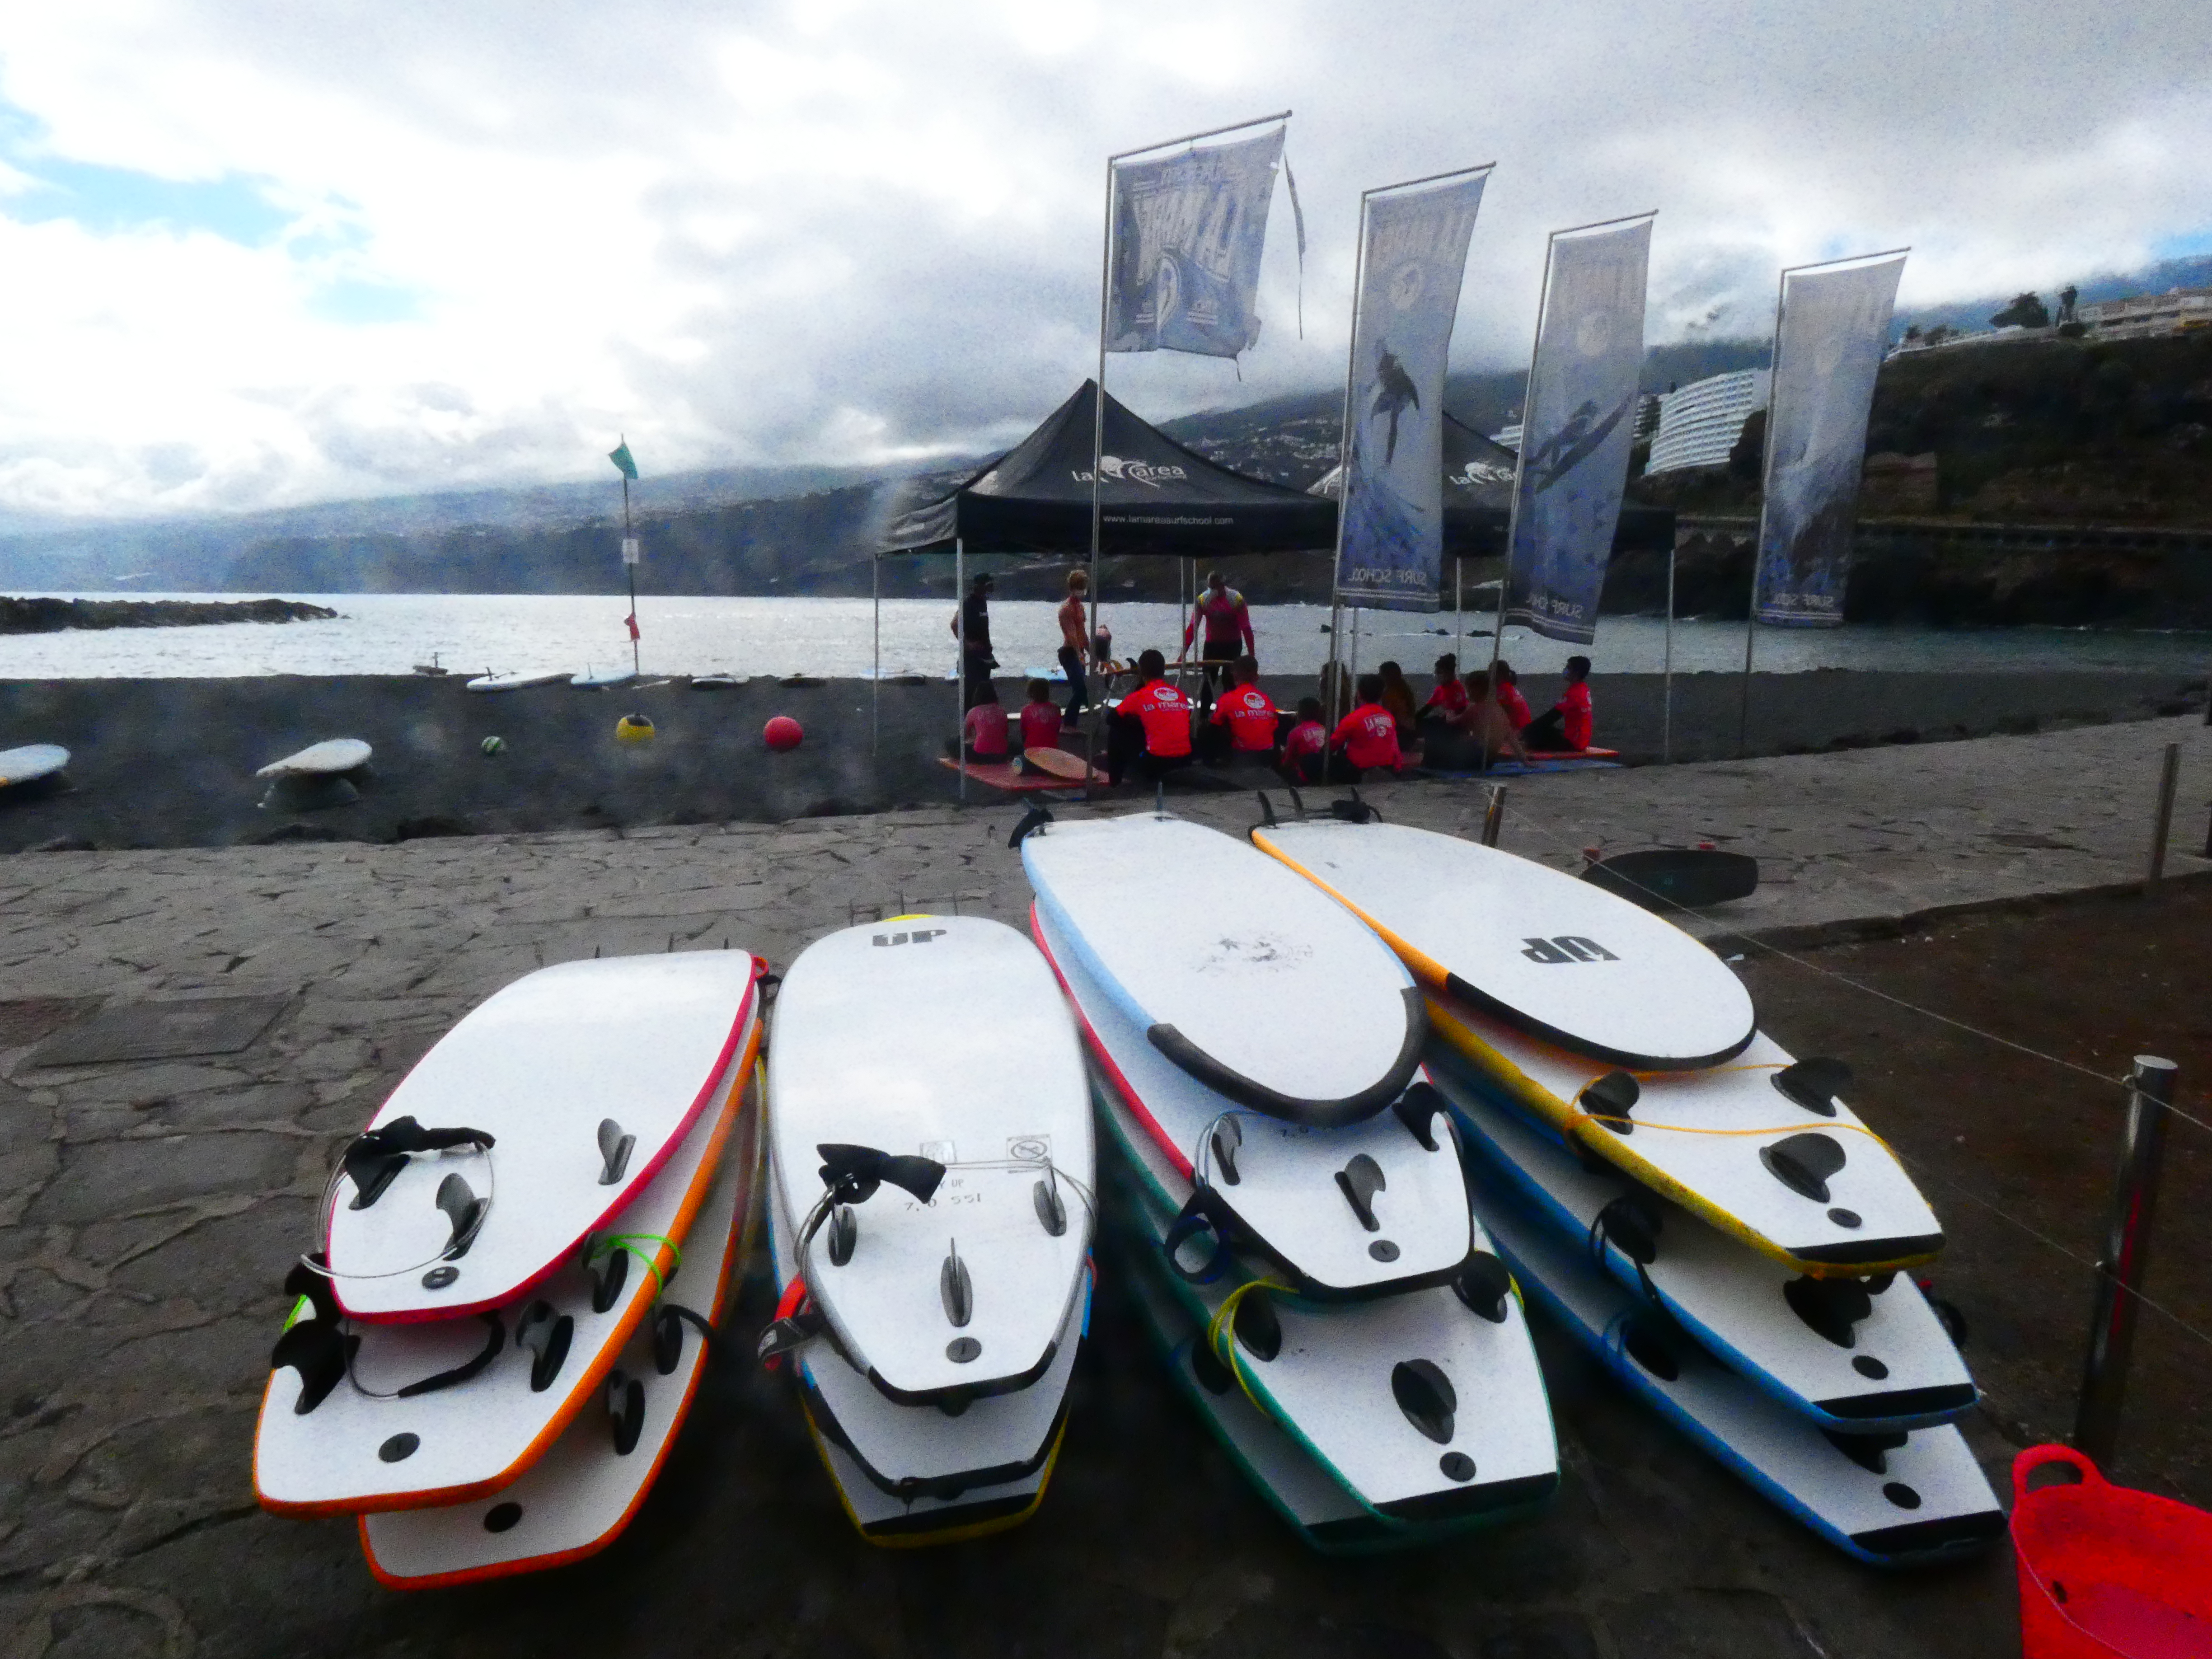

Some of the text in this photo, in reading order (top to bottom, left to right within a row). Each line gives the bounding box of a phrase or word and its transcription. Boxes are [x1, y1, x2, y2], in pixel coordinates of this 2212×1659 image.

[872, 929, 947, 947] UP
[1520, 936, 1621, 963] UP
[951, 1179, 964, 1188] UP
